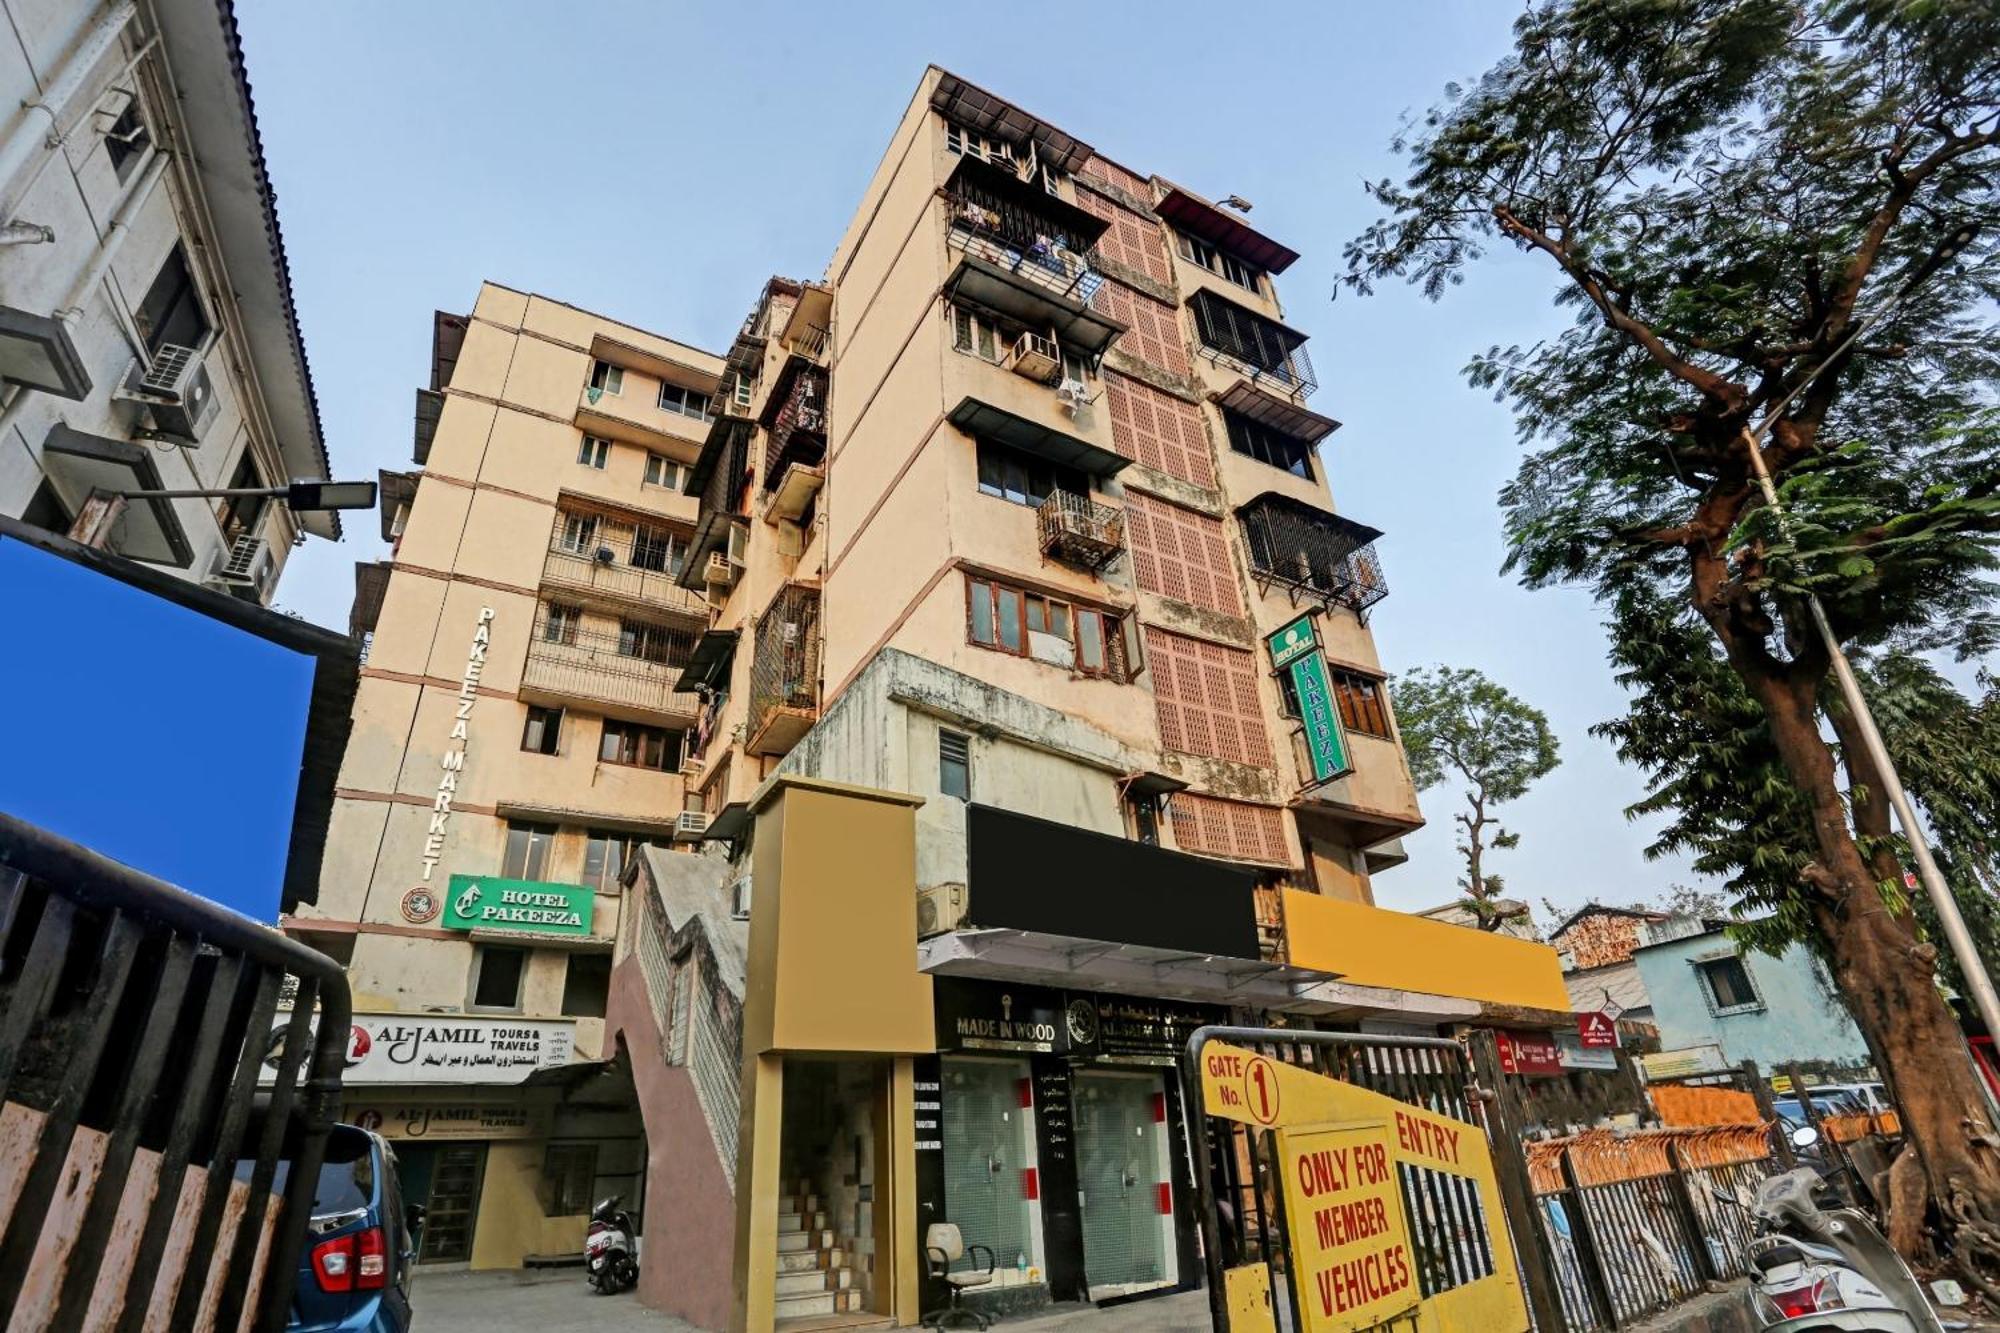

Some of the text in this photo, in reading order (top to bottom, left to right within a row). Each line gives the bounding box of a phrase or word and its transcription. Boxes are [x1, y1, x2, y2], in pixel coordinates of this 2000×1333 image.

[1296, 656, 1339, 776] PAKEEZA
[422, 607, 495, 881] PAKEEZA MARKET
[481, 906, 582, 926] PAKEEZA
[501, 890, 569, 908] HOTEL
[375, 1026, 486, 1065] AL-JAMIL
[492, 1029, 531, 1039] TOURS
[490, 1040, 540, 1051] TRAVELS
[957, 1018, 1055, 1040] MADE IN WOOD
[1207, 1055, 1269, 1117] GATE 1
[1219, 1085, 1242, 1106] No.
[1395, 1110, 1460, 1164] ENTRY
[1298, 1142, 1390, 1198] ONLY FOR
[1314, 1196, 1390, 1251] MEMBER
[1316, 1244, 1410, 1317] VEHICLES
